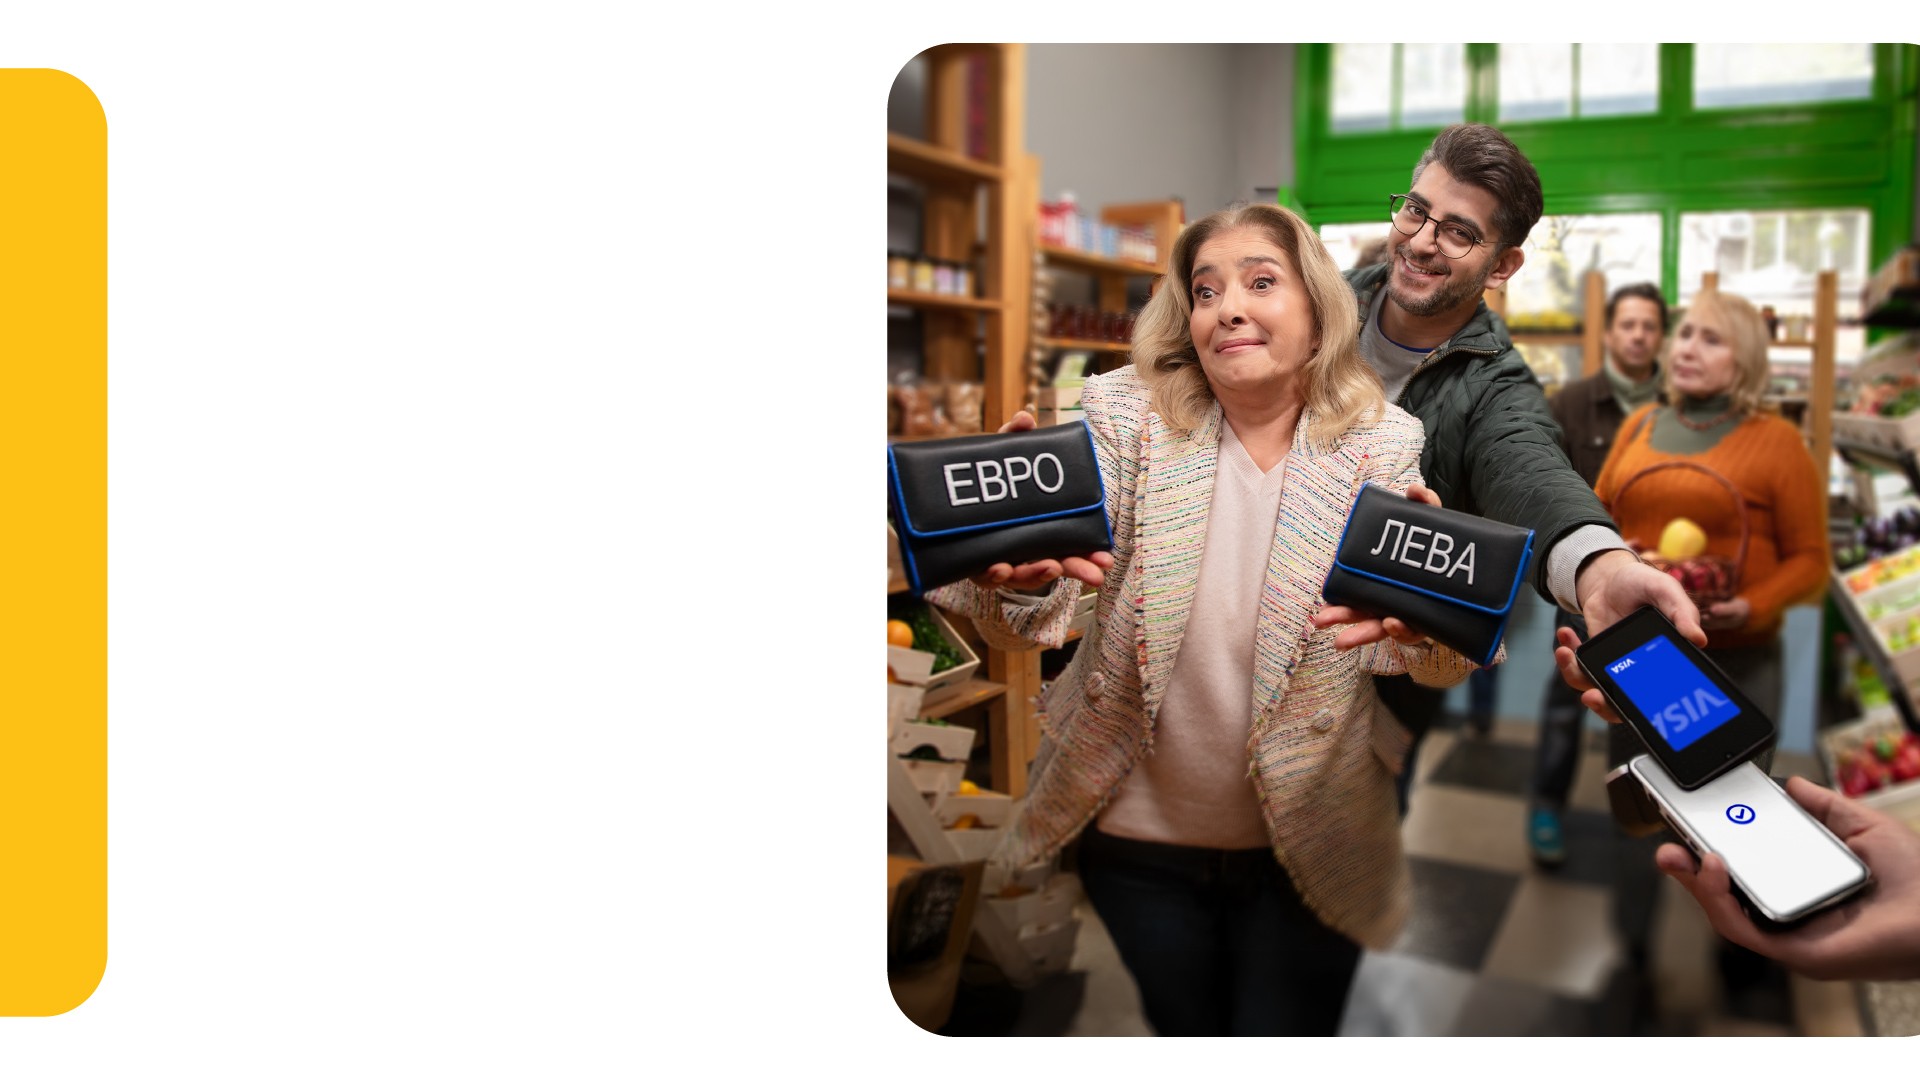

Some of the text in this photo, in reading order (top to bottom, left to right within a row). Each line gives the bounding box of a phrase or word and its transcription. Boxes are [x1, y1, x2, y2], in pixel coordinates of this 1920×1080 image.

[943, 452, 1064, 506] ЕВРО
[1370, 518, 1476, 585] ЛЕВА
[1610, 658, 1636, 674] VISA
